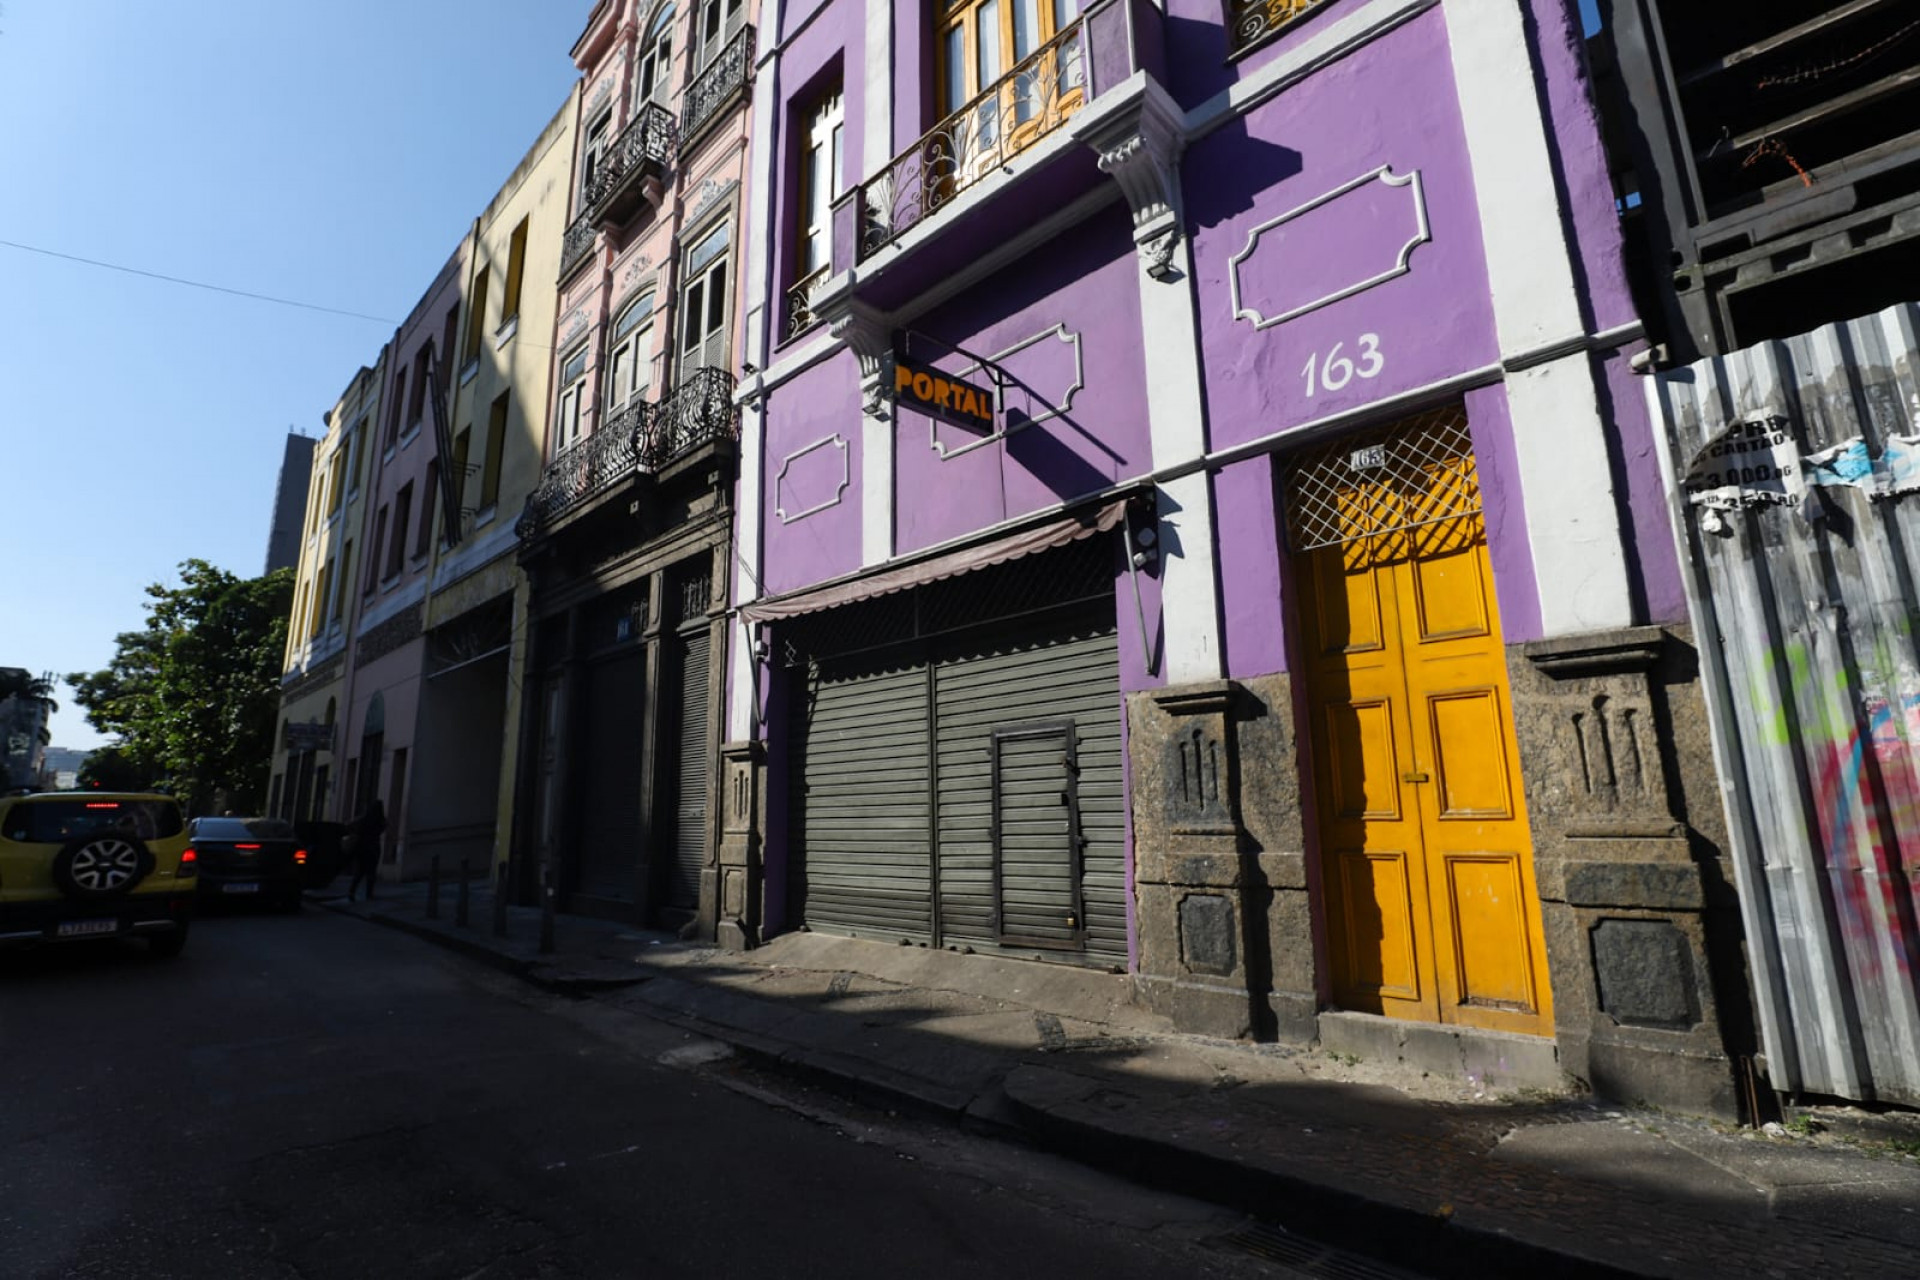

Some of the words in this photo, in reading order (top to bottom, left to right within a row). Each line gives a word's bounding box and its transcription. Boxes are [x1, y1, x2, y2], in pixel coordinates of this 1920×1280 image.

[895, 365, 992, 420] PORTAL
[1301, 333, 1385, 398] 163
[1355, 449, 1382, 467] 163
